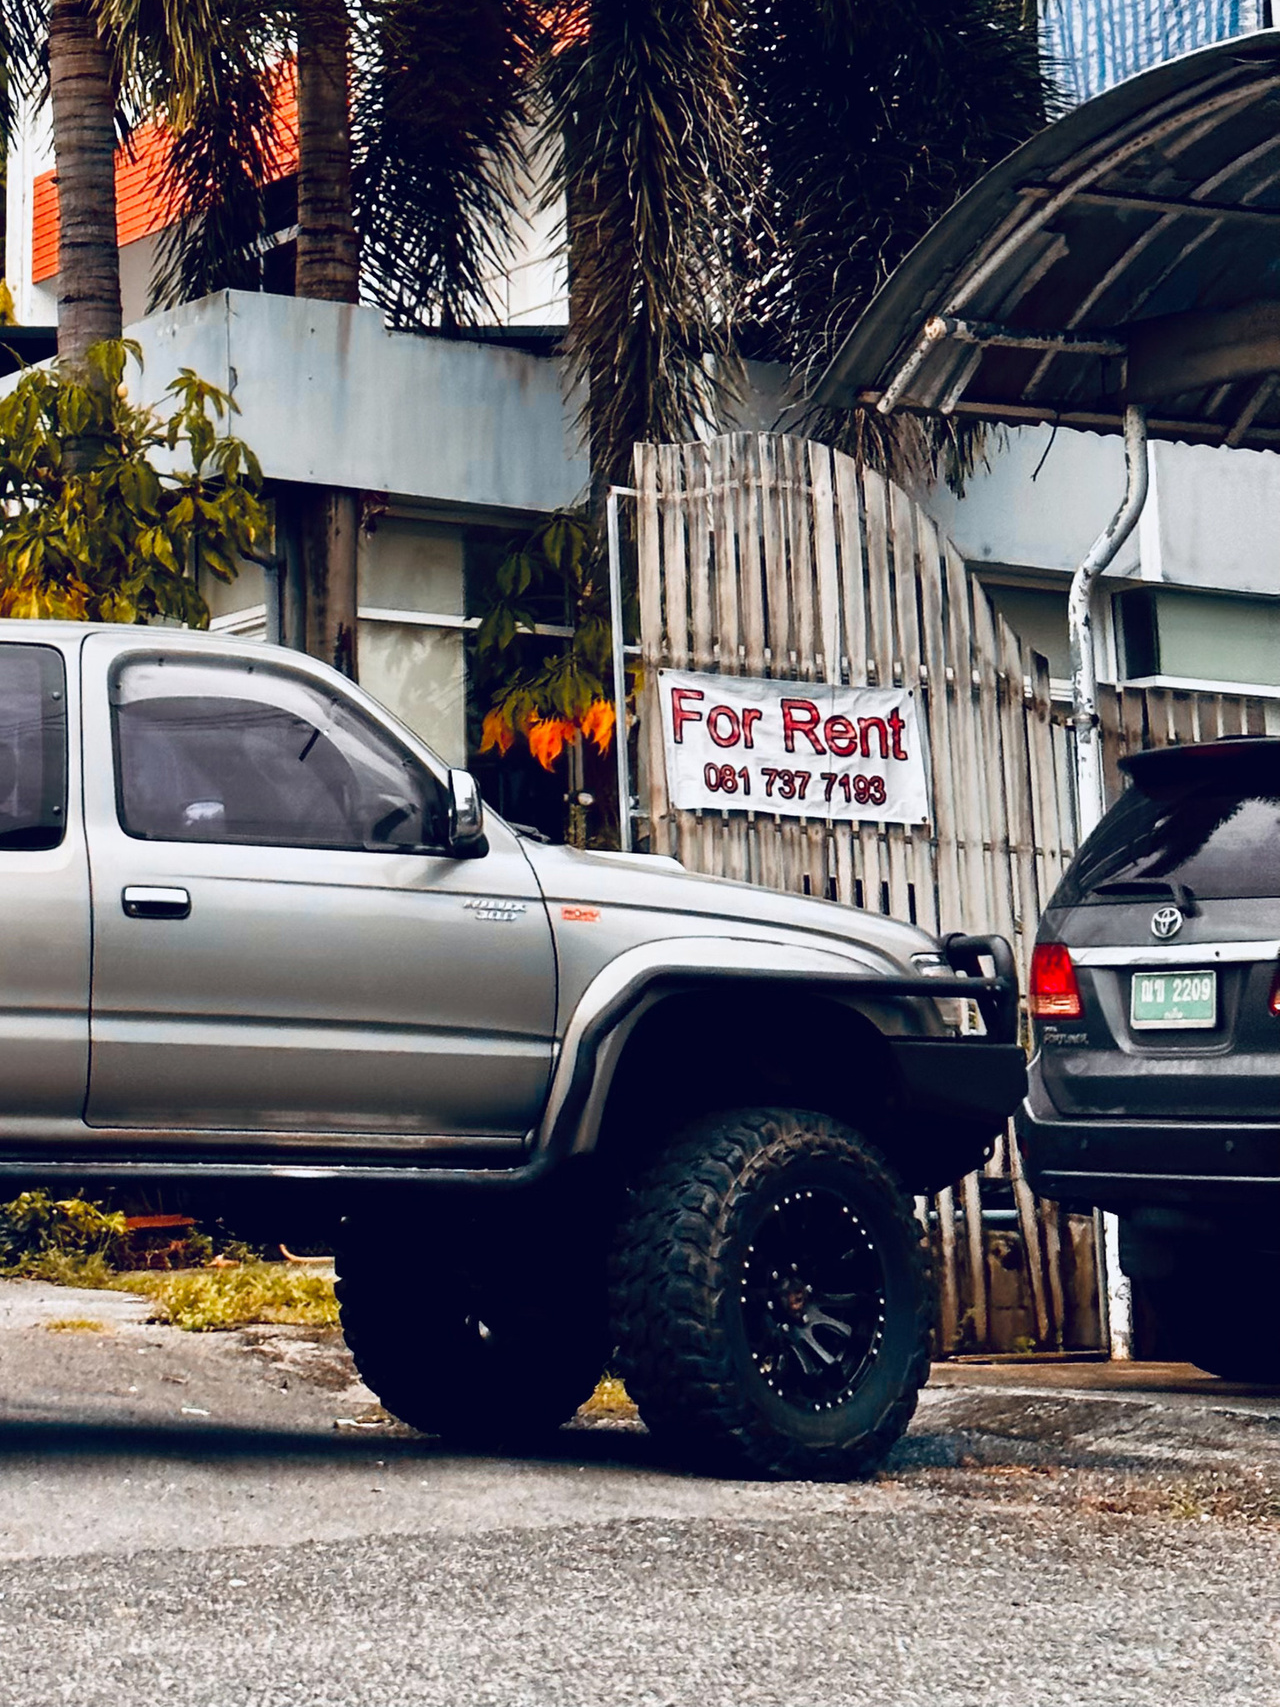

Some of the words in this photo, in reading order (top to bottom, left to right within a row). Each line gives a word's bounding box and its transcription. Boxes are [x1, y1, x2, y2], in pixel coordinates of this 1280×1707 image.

[671, 688, 762, 749] For
[780, 698, 908, 761] Rent
[704, 762, 751, 796] 081
[760, 767, 811, 800] 737
[820, 772, 887, 806] 7193
[1172, 977, 1211, 1003] 2209
